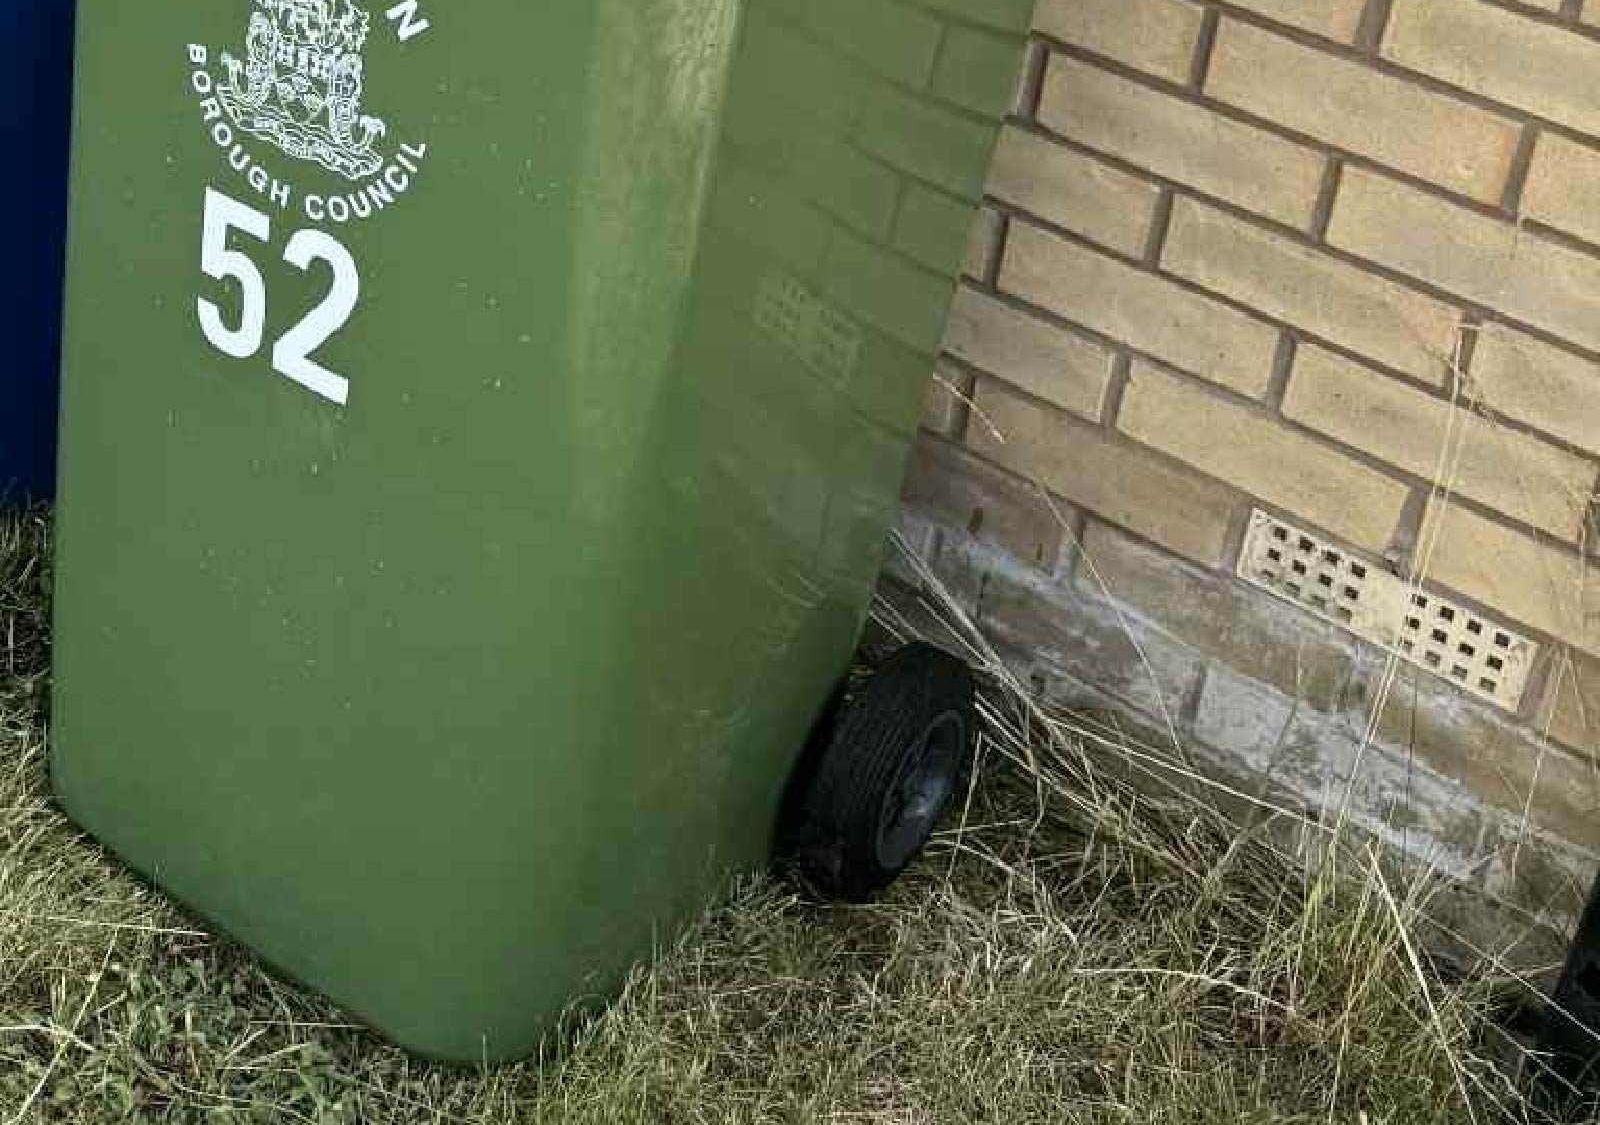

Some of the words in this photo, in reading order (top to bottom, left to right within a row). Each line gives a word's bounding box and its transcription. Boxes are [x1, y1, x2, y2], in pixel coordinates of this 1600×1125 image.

[185, 42, 292, 208] BOROUGH
[303, 141, 427, 223] COUNCIL
[197, 186, 360, 406] 52
